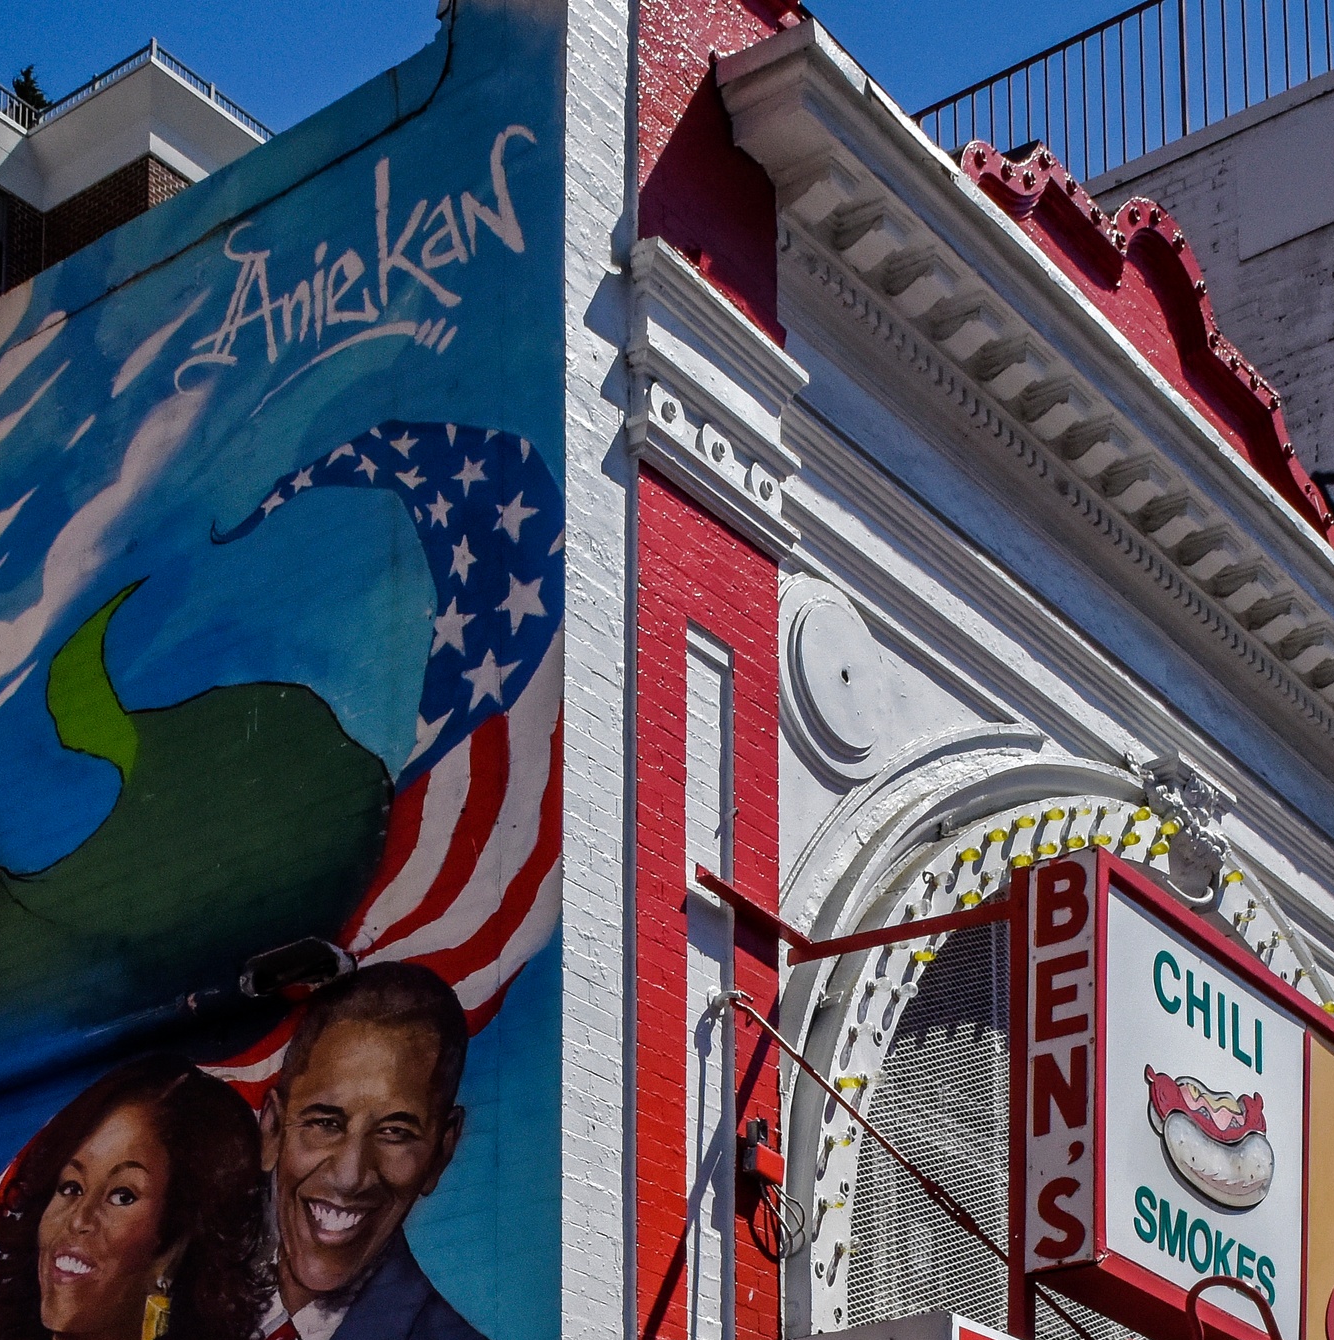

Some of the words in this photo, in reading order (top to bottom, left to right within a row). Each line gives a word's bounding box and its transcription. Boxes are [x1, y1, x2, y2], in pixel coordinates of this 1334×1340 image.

[1033, 856, 1091, 1260] BEN'S
[1153, 950, 1264, 1076] CHILI
[1134, 1186, 1276, 1307] SMOKES
